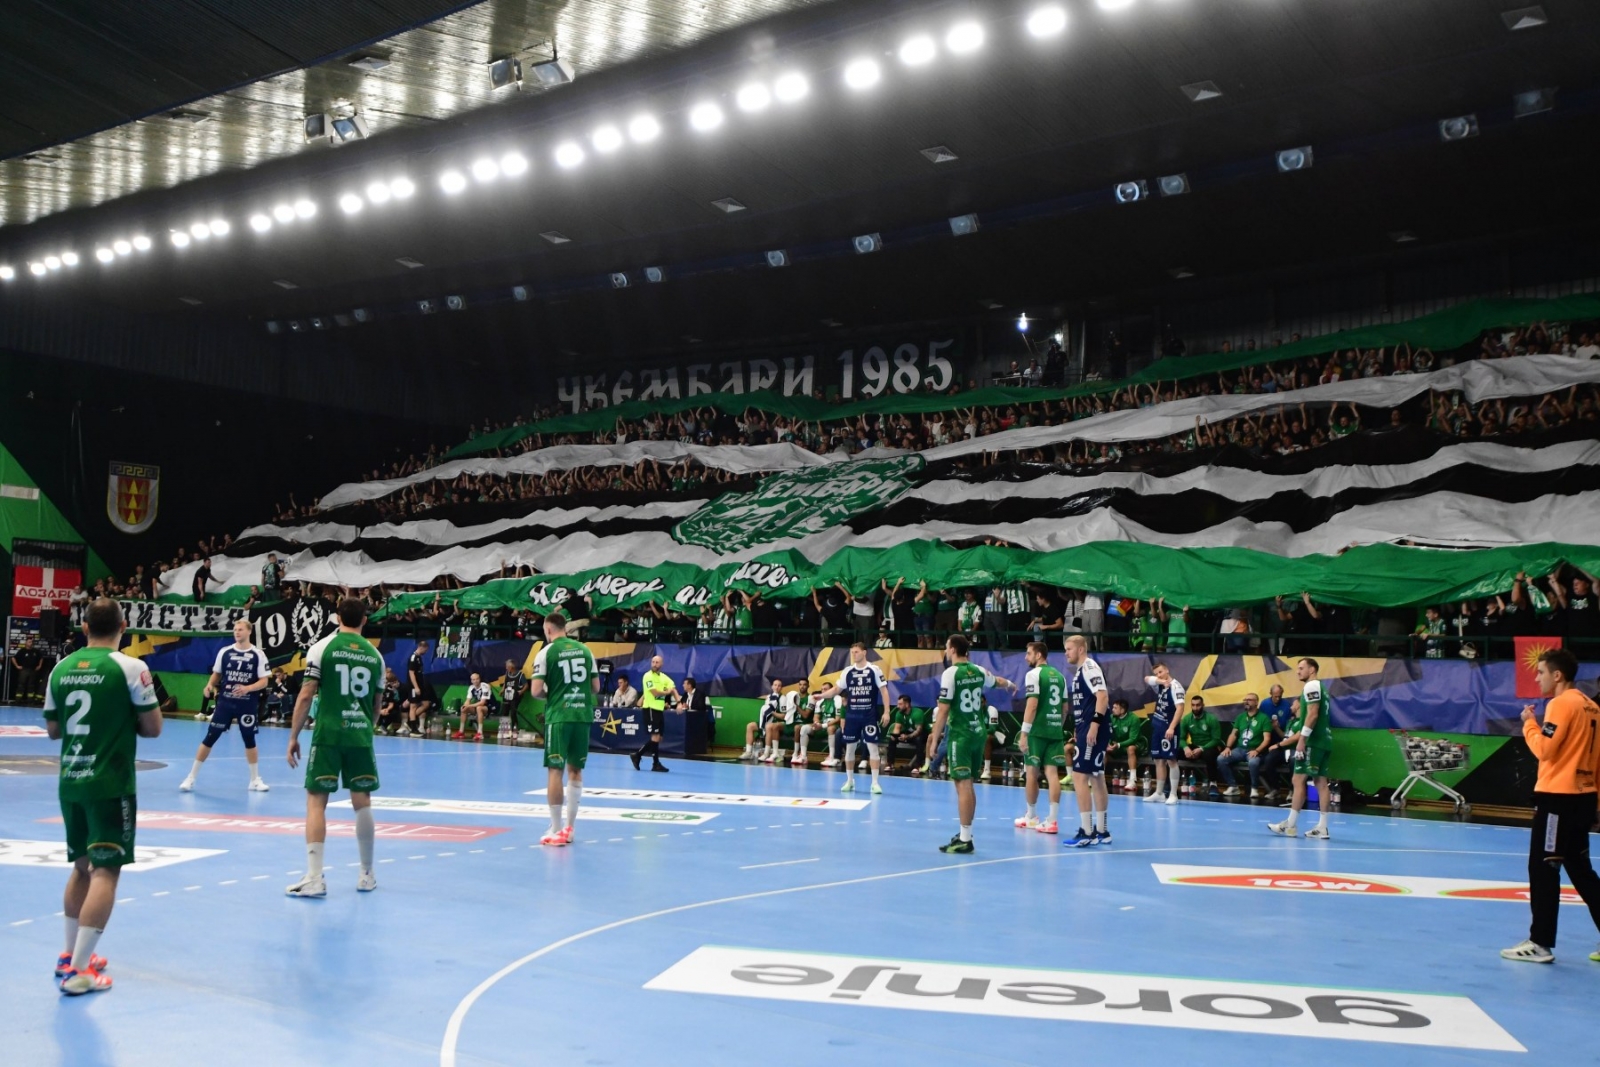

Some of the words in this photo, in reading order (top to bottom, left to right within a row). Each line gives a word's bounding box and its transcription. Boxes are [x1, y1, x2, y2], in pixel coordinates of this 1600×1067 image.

[837, 339, 954, 399] 1985
[75, 601, 246, 631] ЛИСТЕР
[252, 612, 287, 650] 19
[236, 661, 243, 670] 7
[558, 658, 587, 684] 15
[335, 664, 371, 698] 18
[857, 677, 863, 686] 3
[1049, 685, 1060, 706] 3
[65, 689, 92, 735] 2
[960, 687, 981, 713] 88
[1590, 719, 1597, 753] 1
[1247, 877, 1371, 892] MOL
[730, 962, 1432, 1029] gorenje
